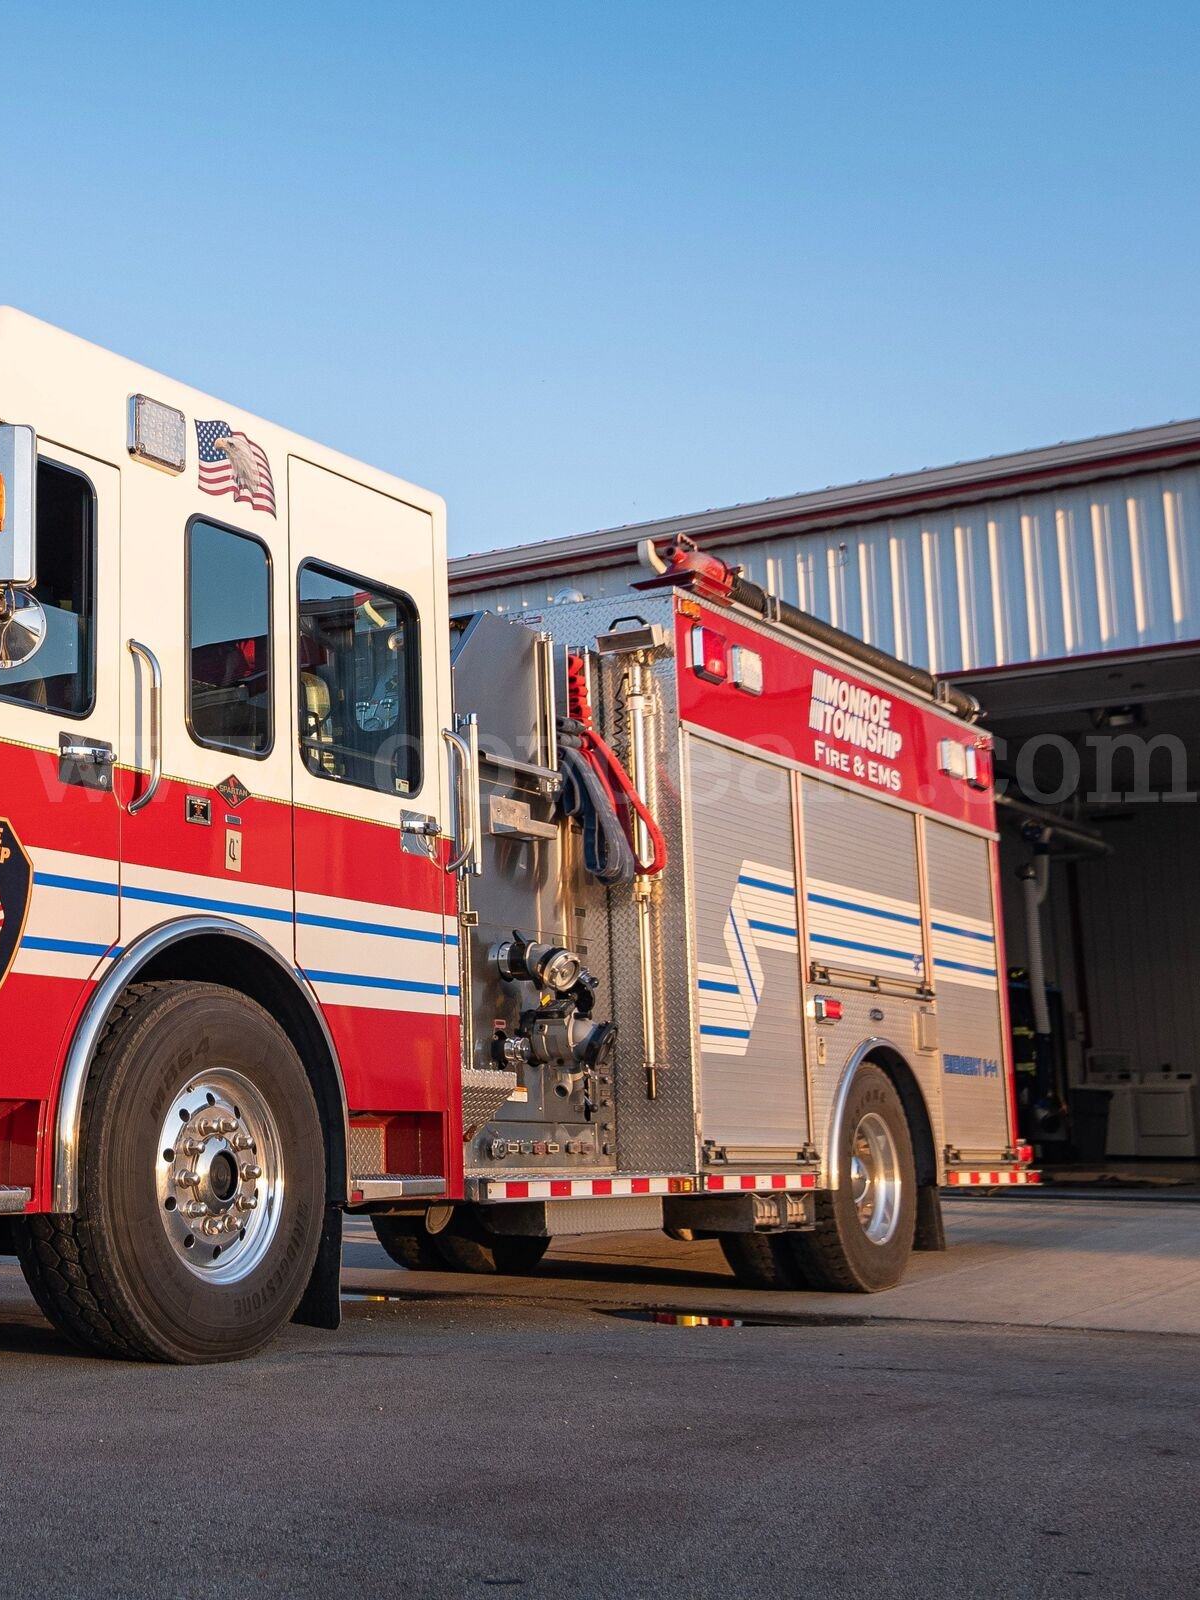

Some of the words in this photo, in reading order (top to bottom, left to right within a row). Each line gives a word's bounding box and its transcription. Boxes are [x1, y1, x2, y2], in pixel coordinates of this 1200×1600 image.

[825, 674, 891, 728] MONROE
[823, 704, 902, 759] TOWNSHIP
[219, 784, 248, 797] SPARTAN
[814, 739, 850, 772] FIRE
[853, 755, 865, 777] &
[867, 761, 901, 791] EMS
